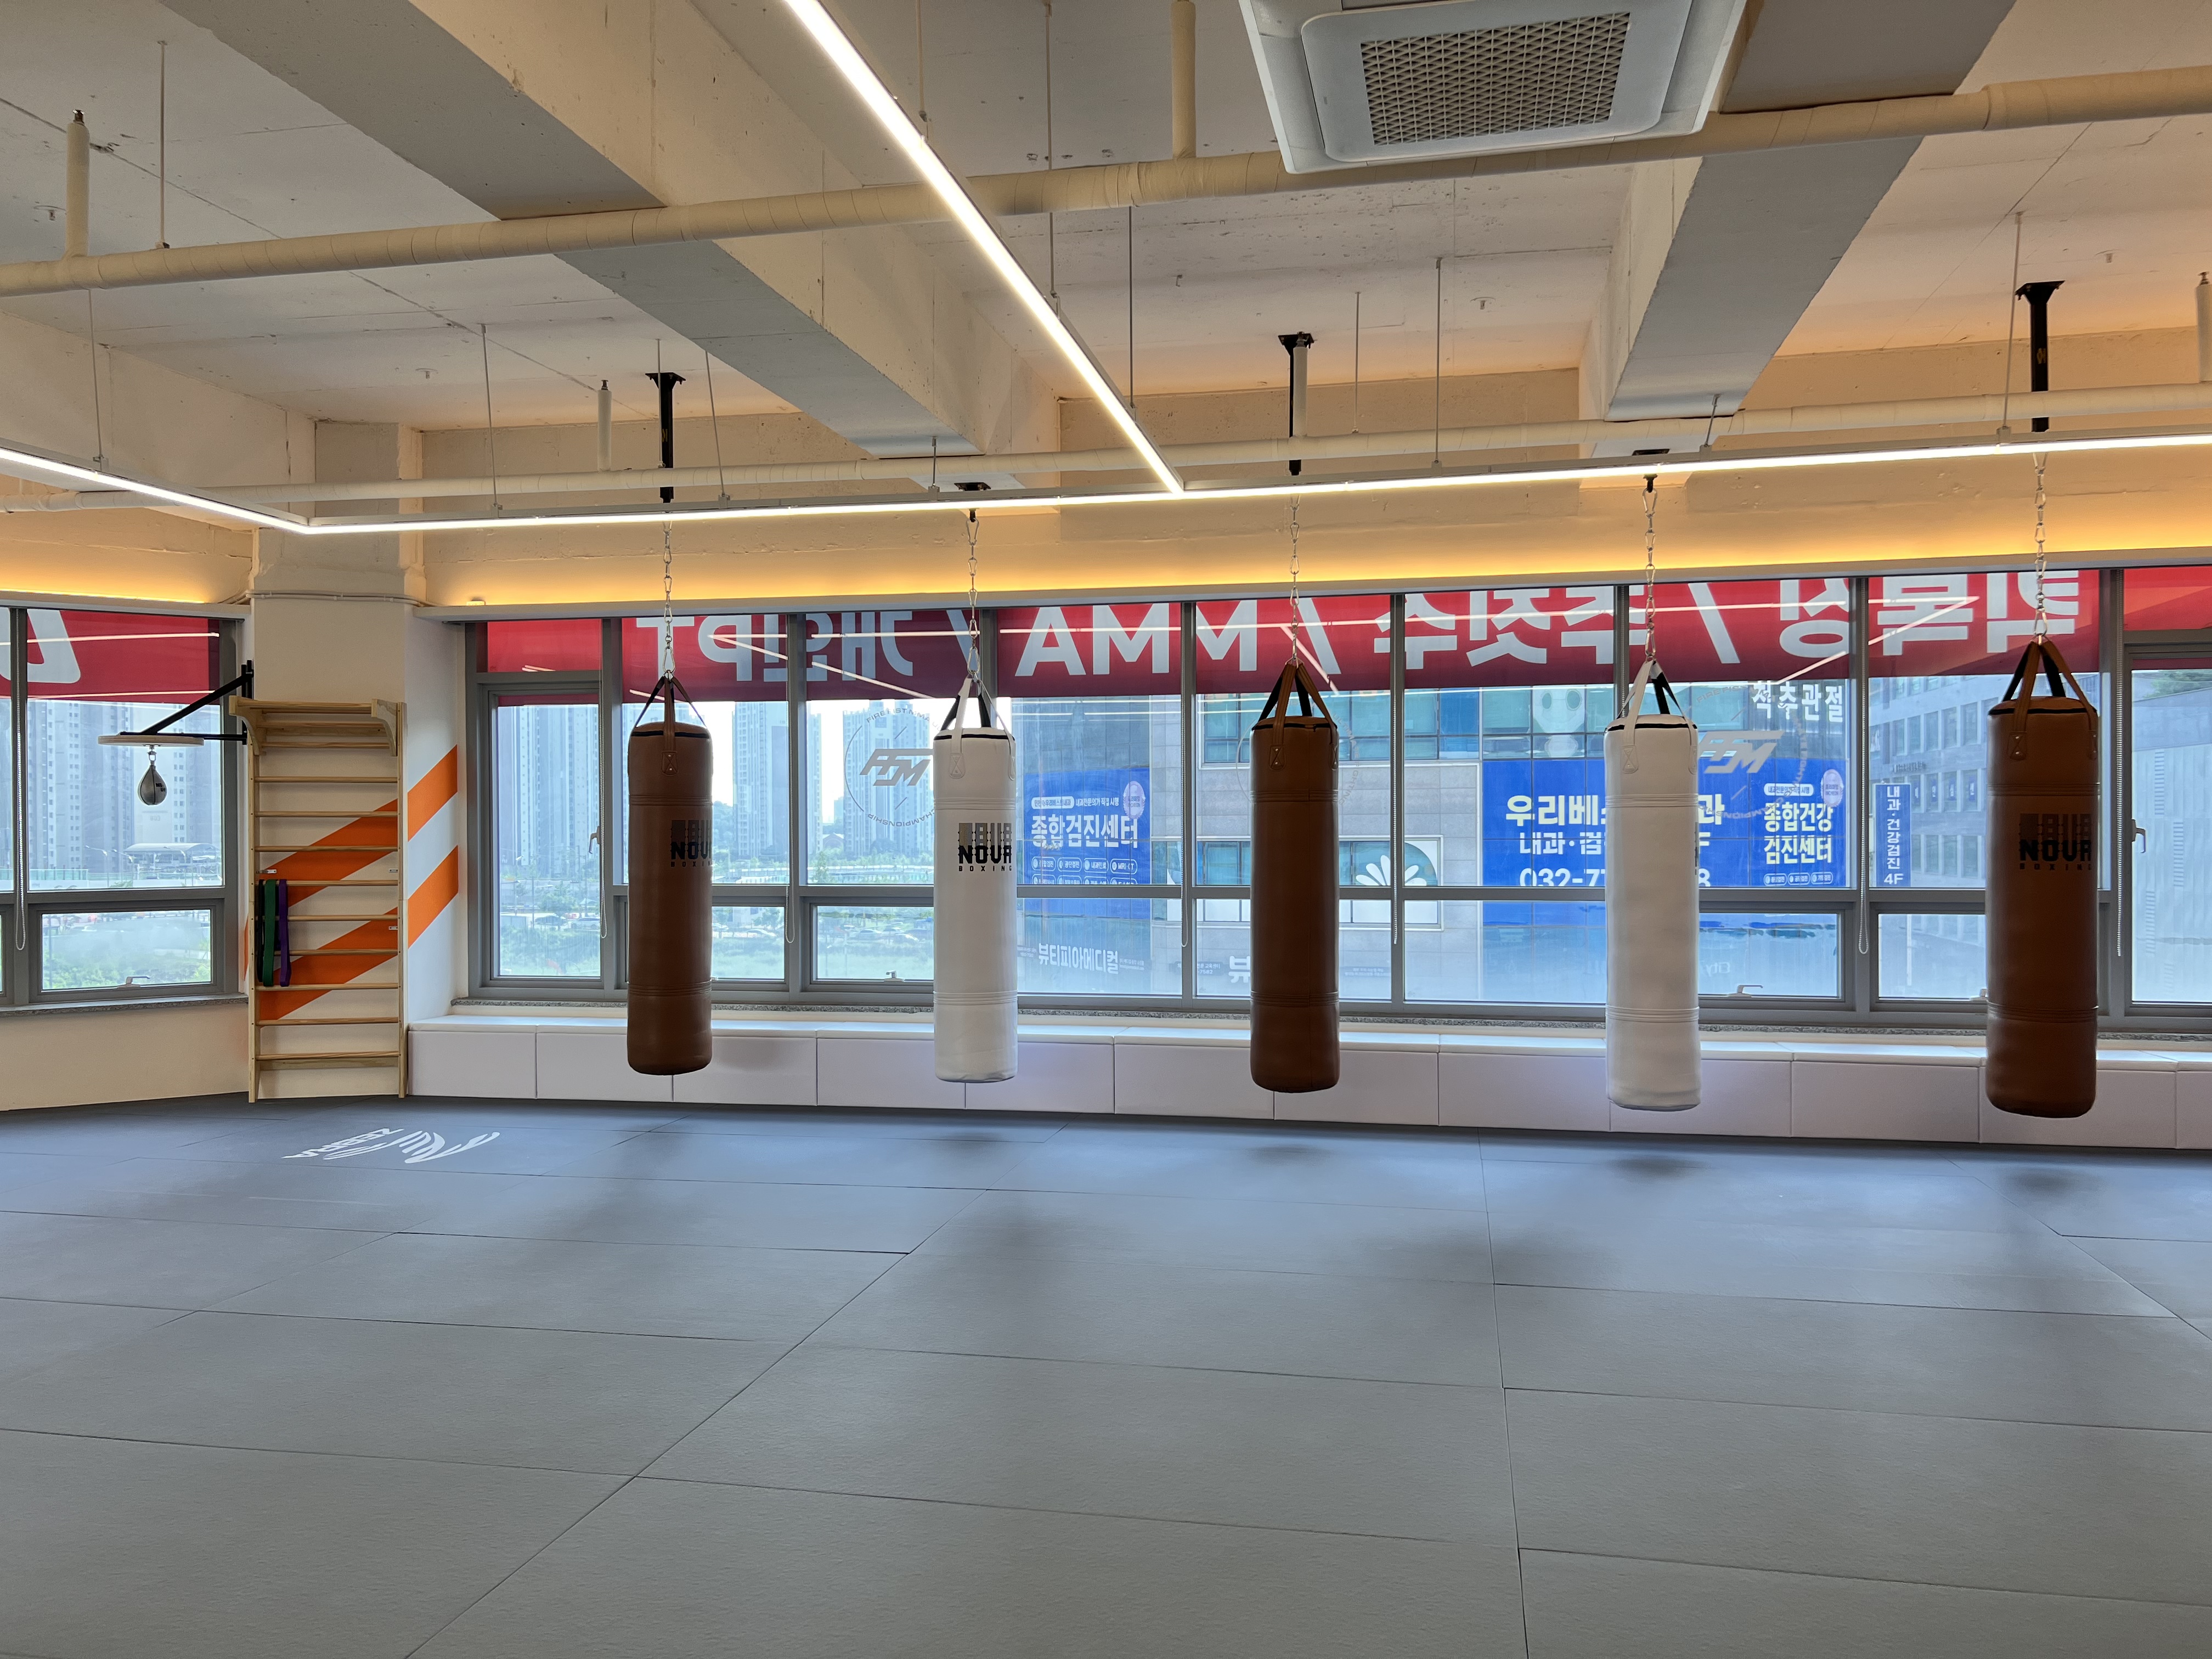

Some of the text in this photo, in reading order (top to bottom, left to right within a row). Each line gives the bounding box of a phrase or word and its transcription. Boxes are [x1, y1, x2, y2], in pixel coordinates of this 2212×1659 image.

[866, 710, 886, 723] FIRE
[1752, 680, 1843, 723] 척추관절
[1031, 814, 1138, 849] 종합검진센터
[1764, 802, 1833, 832] 종합건강
[670, 842, 712, 860] NOV
[1764, 834, 1832, 865] 검진센터
[1883, 873, 1904, 885] 4F
[1039, 943, 1119, 975] 뷰티피아메디컬
